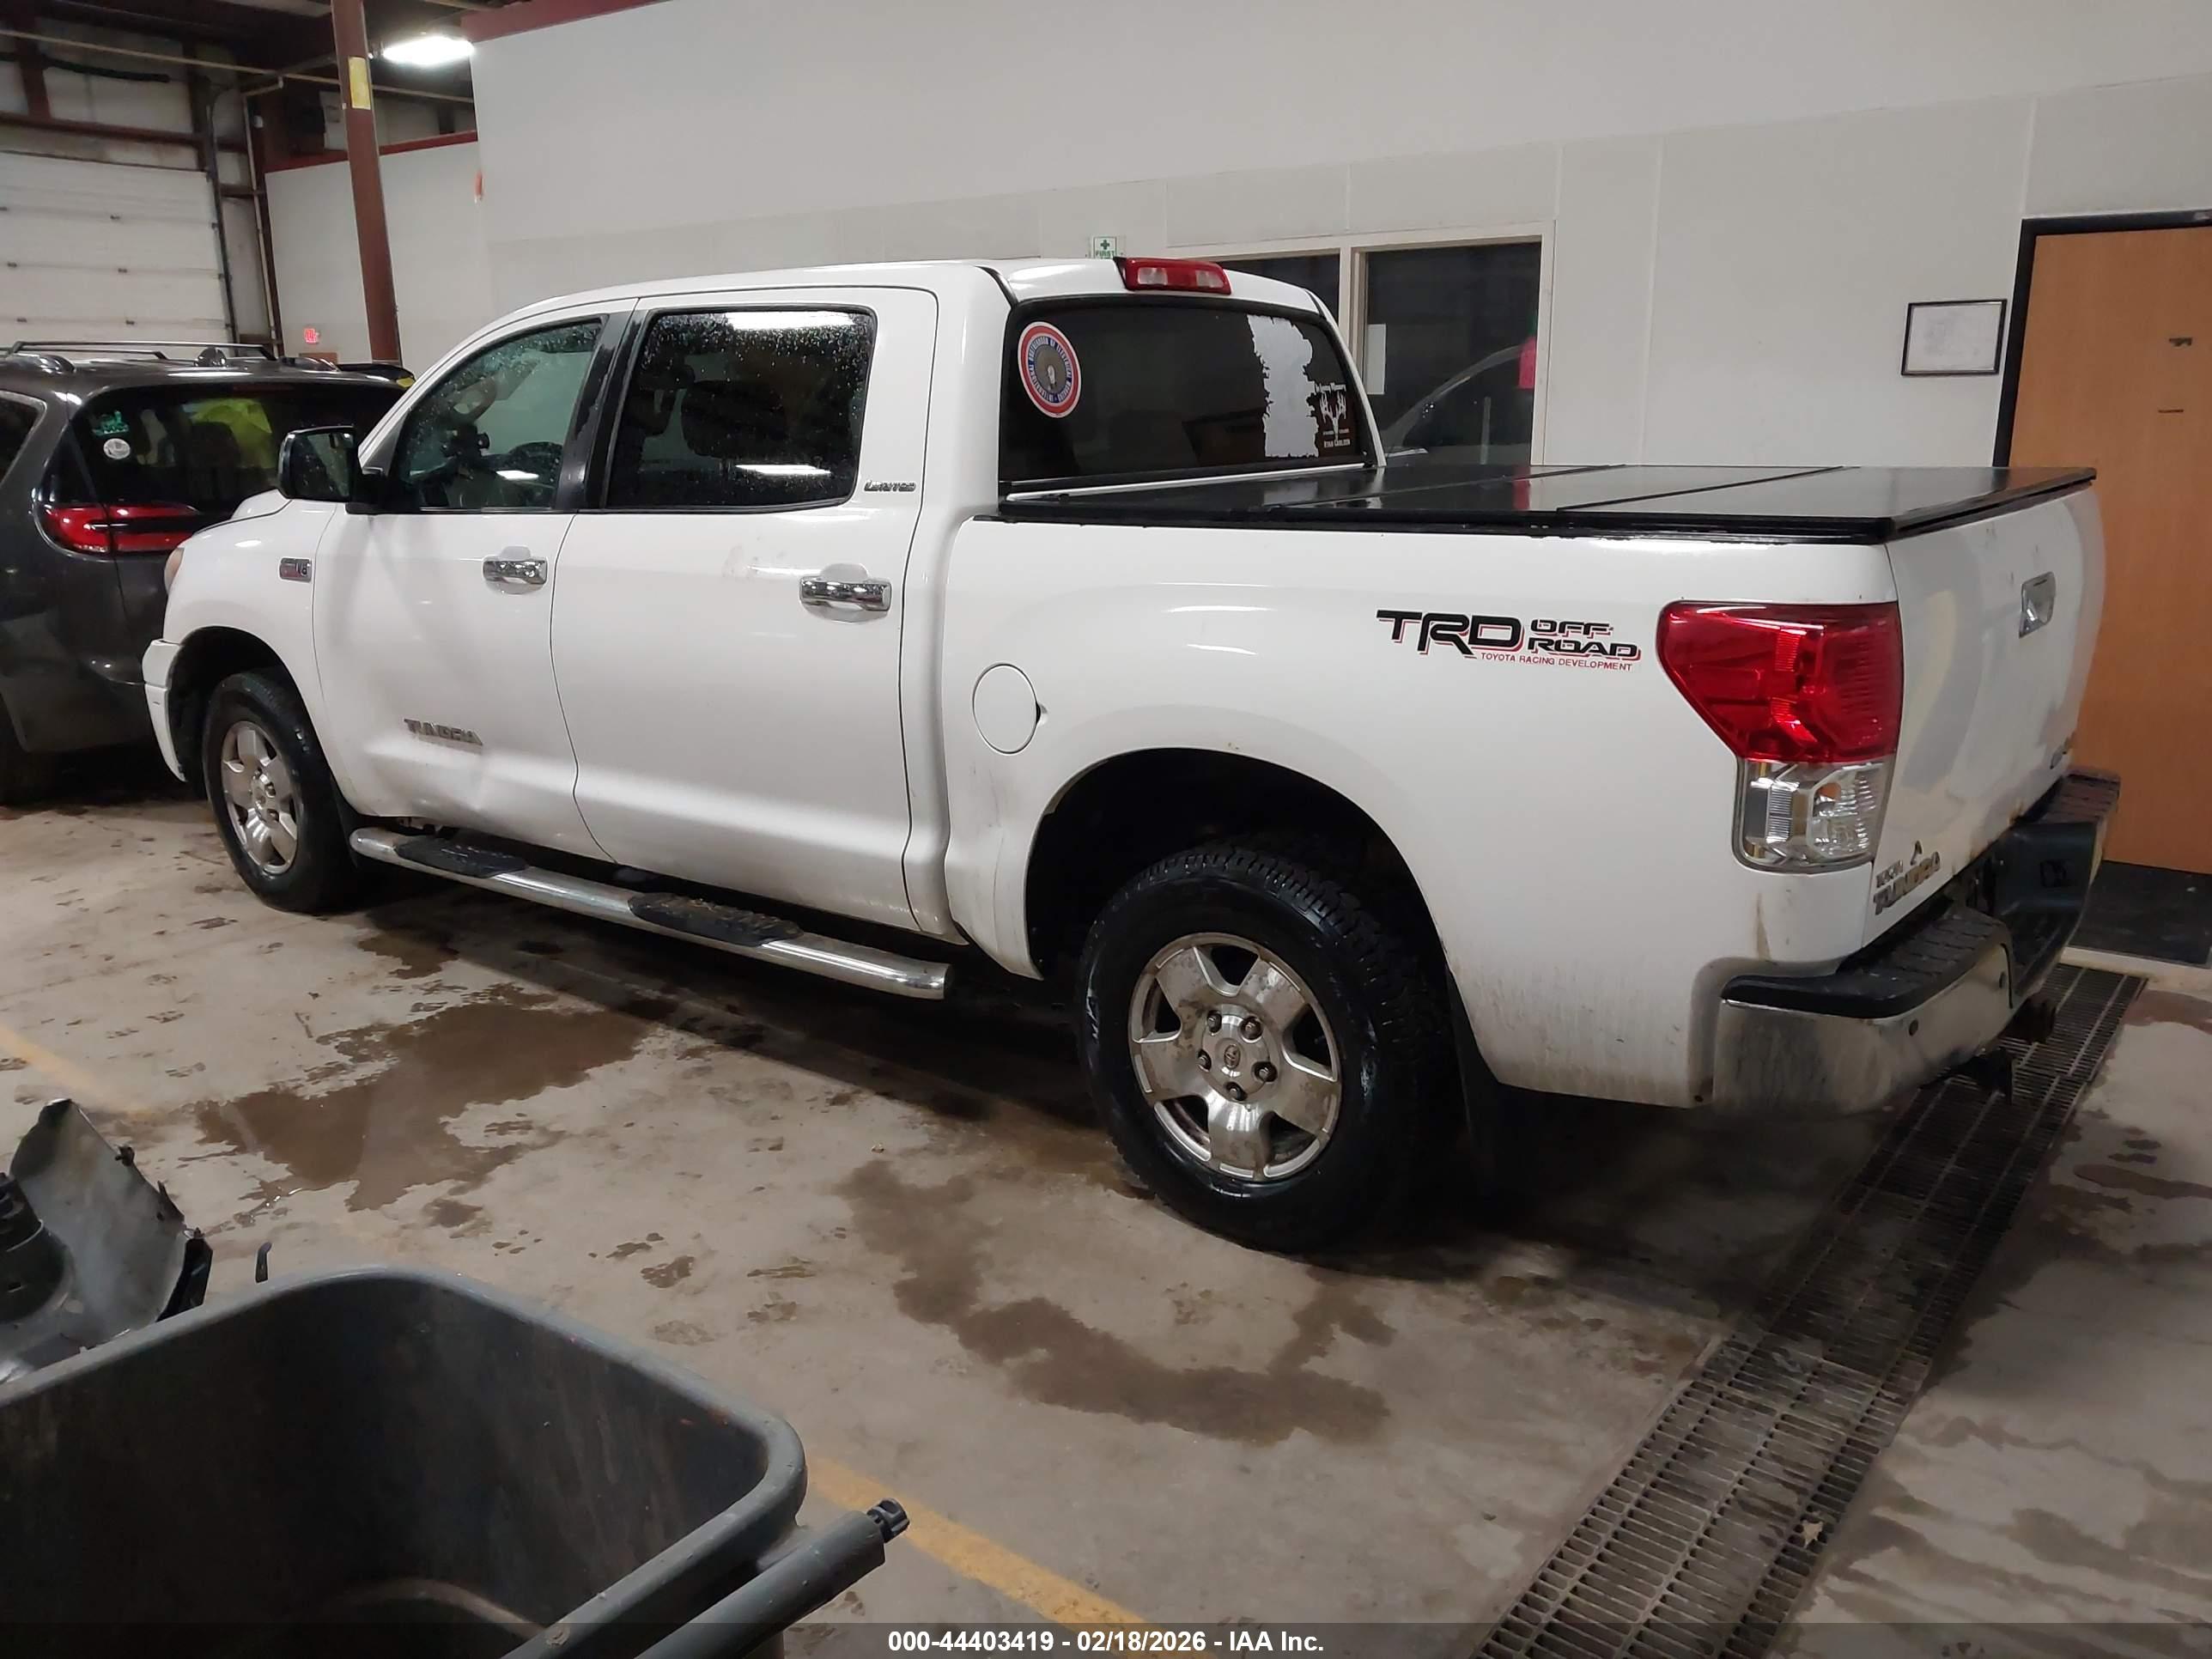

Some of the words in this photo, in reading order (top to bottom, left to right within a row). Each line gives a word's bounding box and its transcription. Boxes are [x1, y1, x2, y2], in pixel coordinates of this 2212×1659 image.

[1376, 610, 1524, 659] TRD
[1529, 618, 1614, 639] OFF
[1527, 636, 1642, 661] ROAD
[1480, 651, 1516, 663] TOYOTA
[1519, 655, 1556, 666] RACING
[1558, 658, 1633, 672] DEVELOPMENT
